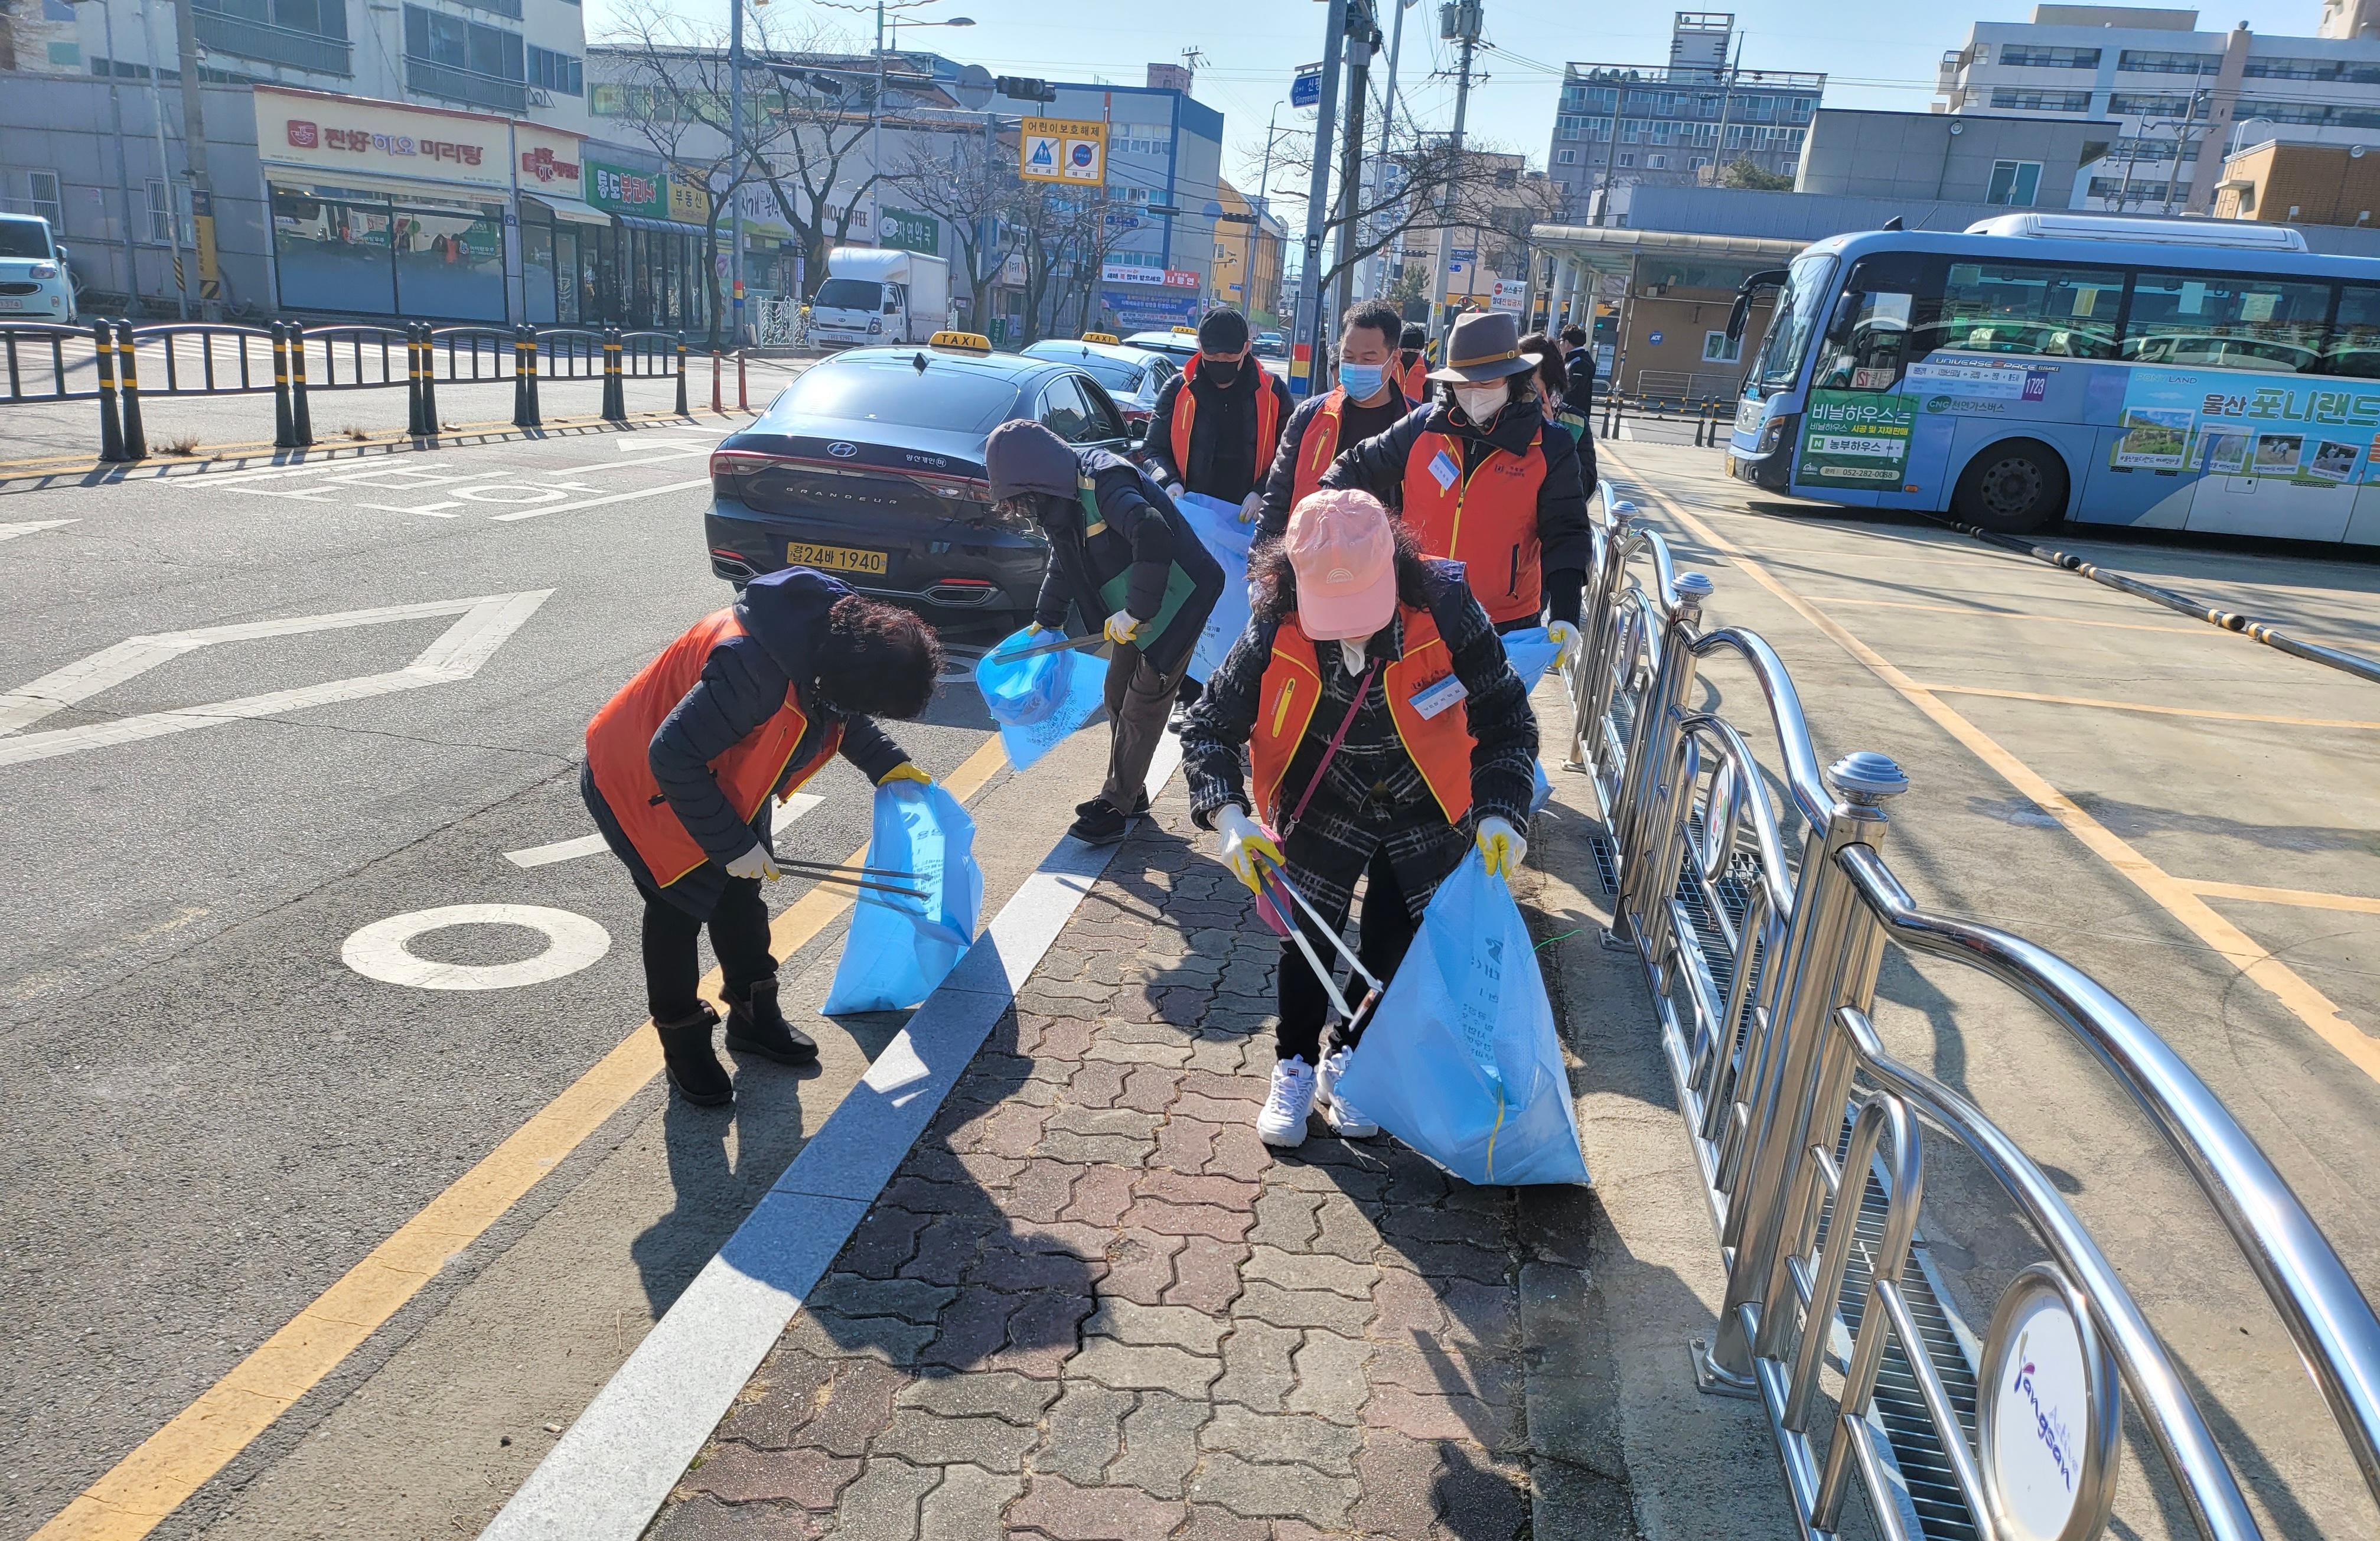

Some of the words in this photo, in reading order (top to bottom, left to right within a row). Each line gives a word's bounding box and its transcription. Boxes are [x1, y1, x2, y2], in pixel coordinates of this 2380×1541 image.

[1028, 122, 1099, 136] 어린이보호해제
[676, 189, 702, 208] 부동산
[892, 221, 930, 248] 자연약국
[1503, 285, 1523, 295] 버스출구
[942, 334, 977, 347] TAXI
[2026, 377, 2043, 395] 1723
[1812, 403, 1911, 425] 비닐하우스는
[1951, 400, 2005, 413] 천연가스버스
[2202, 393, 2247, 417] 울산
[2248, 388, 2380, 427] 포니랜드
[1810, 422, 1847, 432] 비닐하우스
[1851, 424, 1867, 433] 시공
[1869, 425, 1876, 434] 및
[1877, 426, 1909, 436] 자재판매
[1830, 439, 1881, 452] 농부하우스
[1843, 468, 1893, 478] 052-282-0088
[786, 487, 897, 504] GRANDEUR
[793, 545, 803, 562] 경남
[804, 546, 834, 565] 24바
[840, 550, 880, 571] 1940
